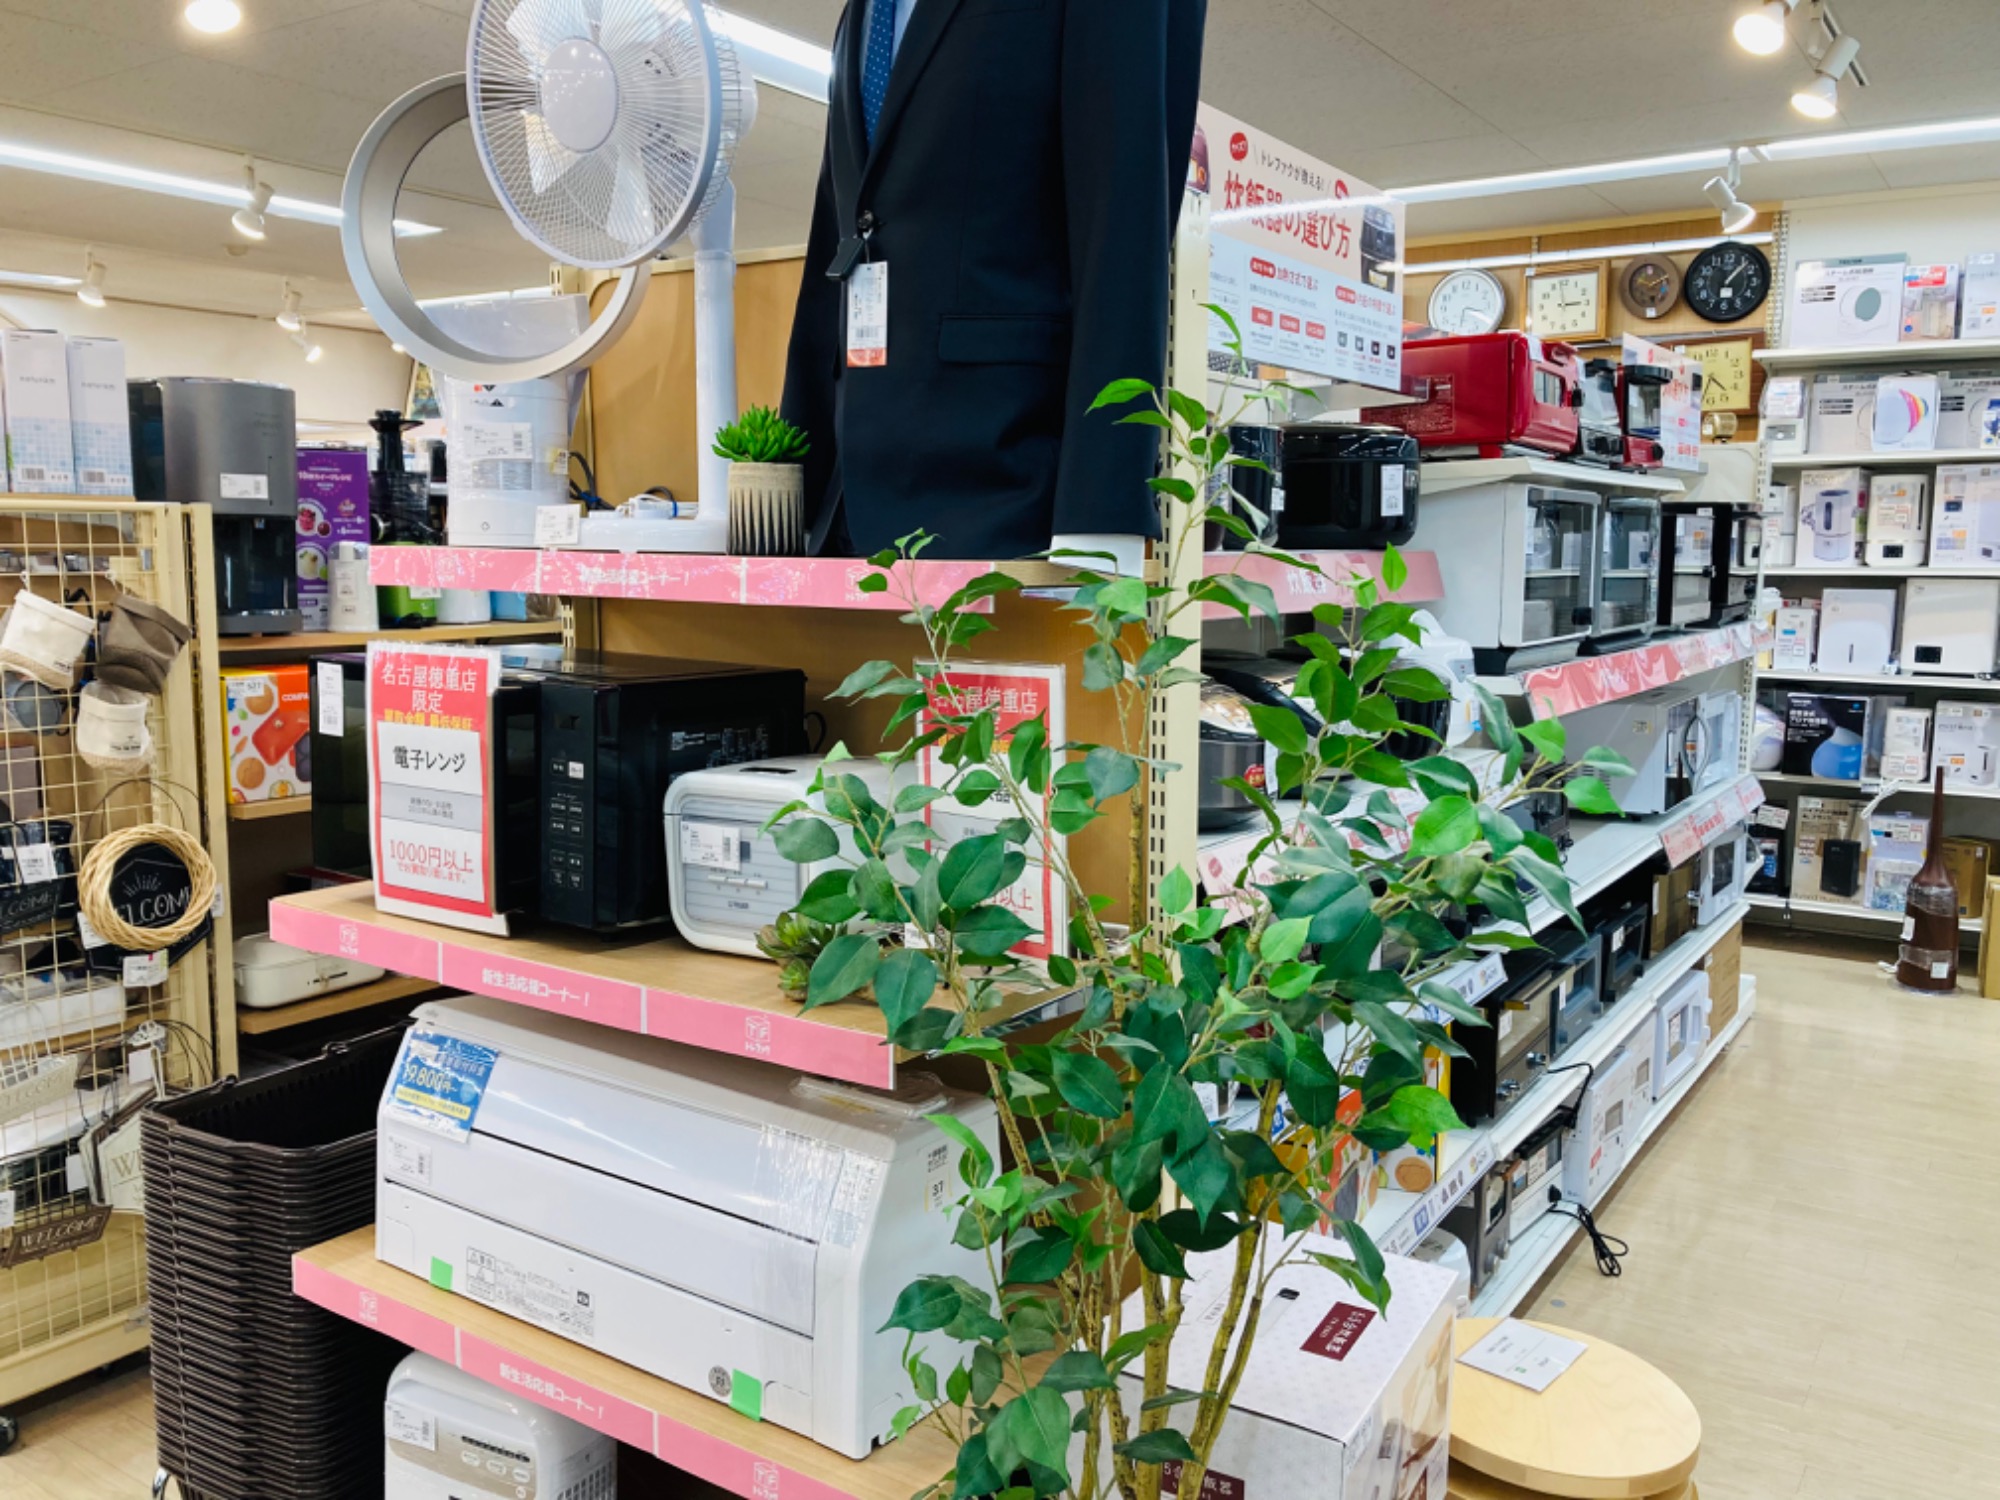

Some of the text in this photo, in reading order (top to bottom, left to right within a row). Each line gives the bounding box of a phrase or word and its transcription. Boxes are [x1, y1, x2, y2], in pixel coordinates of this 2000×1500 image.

[1712, 256, 1721, 265] 11
[1724, 254, 1735, 263] 12
[1741, 256, 1746, 265] 1
[1702, 266, 1713, 275] 10
[1747, 265, 1755, 274] 2
[1751, 277, 1757, 286] 3
[1700, 289, 1707, 299] 8
[1744, 289, 1752, 298] 4
[1708, 300, 1715, 308] 7
[1720, 301, 1728, 310] 6
[1734, 300, 1741, 309] 5
[381, 665, 478, 693] 名古屋徳重店
[412, 690, 443, 714] 限定
[393, 745, 467, 773] 電子レンジ
[390, 839, 475, 874] 1000円以上
[482, 968, 590, 1006] 新生活応援コーナー!
[500, 1362, 605, 1419] 新生活応援コーナー!
